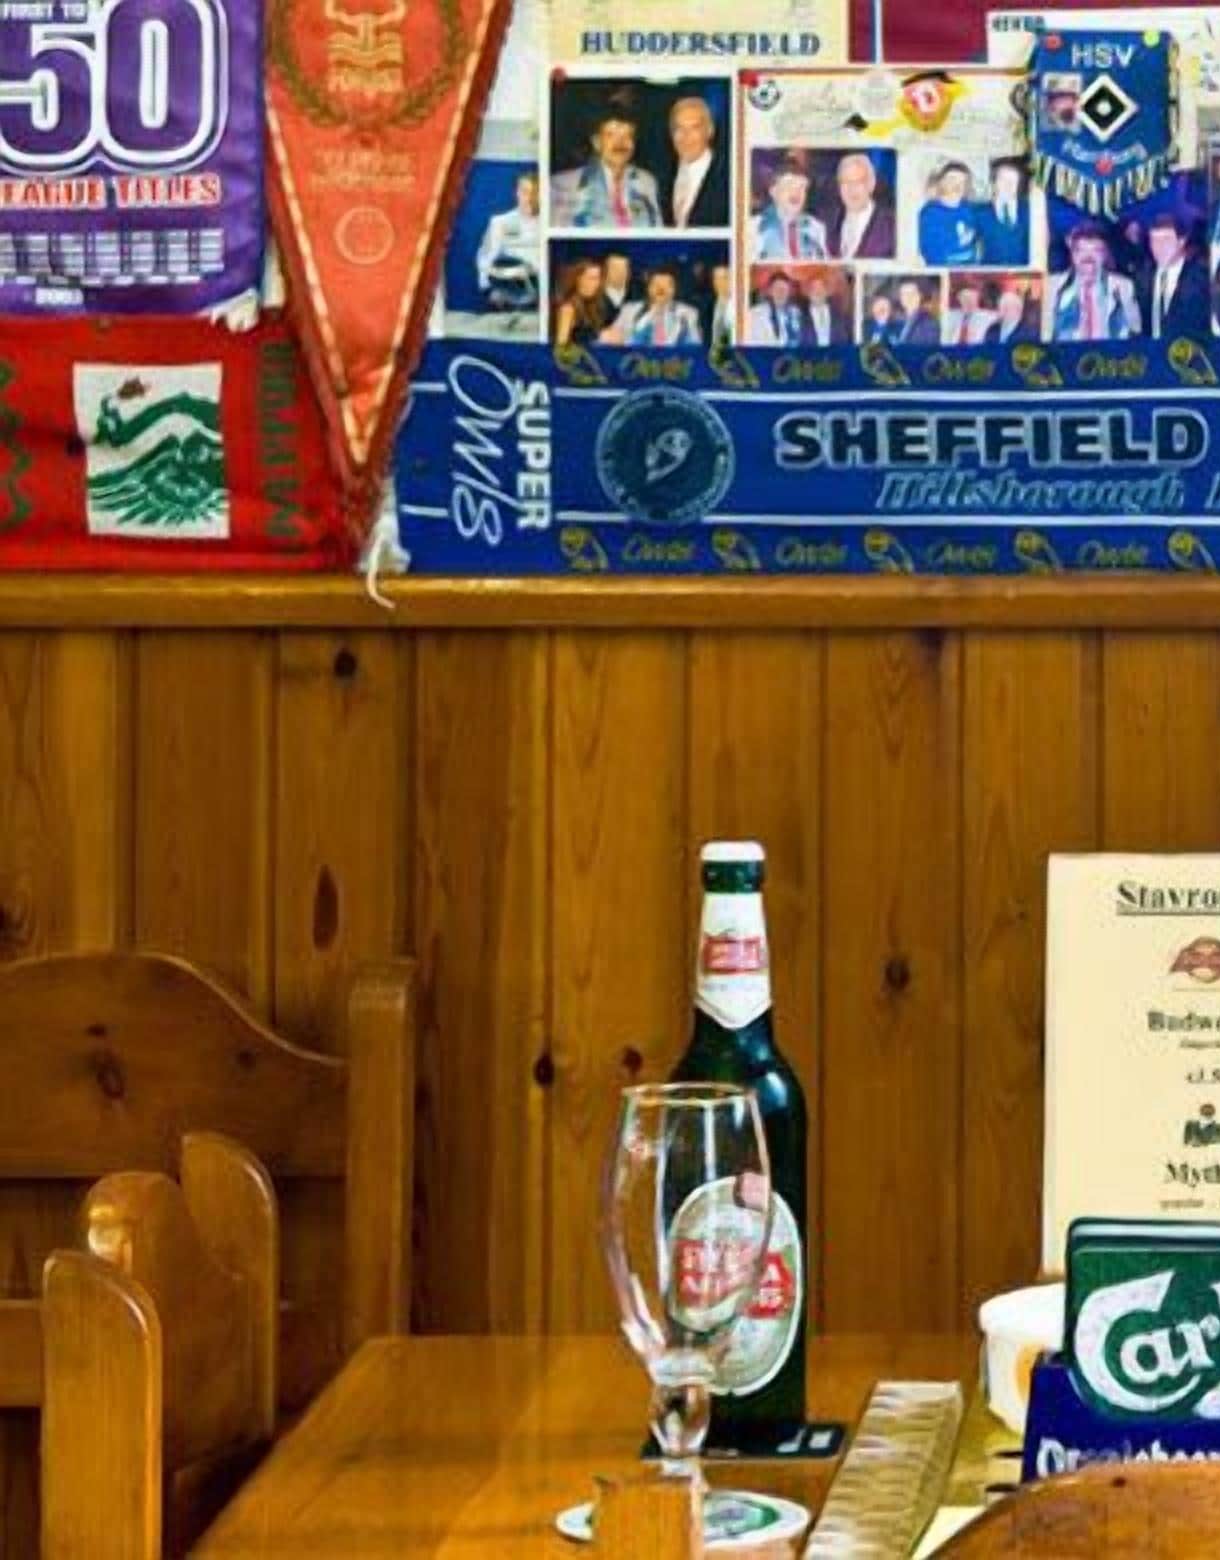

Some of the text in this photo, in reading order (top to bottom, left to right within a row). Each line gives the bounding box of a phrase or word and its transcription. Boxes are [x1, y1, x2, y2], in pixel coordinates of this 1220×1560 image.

[580, 30, 820, 57] HUDDERSFIELD
[1071, 42, 1136, 69] HSV
[0, 0, 228, 175] 50
[112, 172, 222, 209] TITLES
[448, 354, 518, 546] Owls
[516, 380, 550, 529] SUPER
[774, 408, 1209, 469] SHEFFIELD
